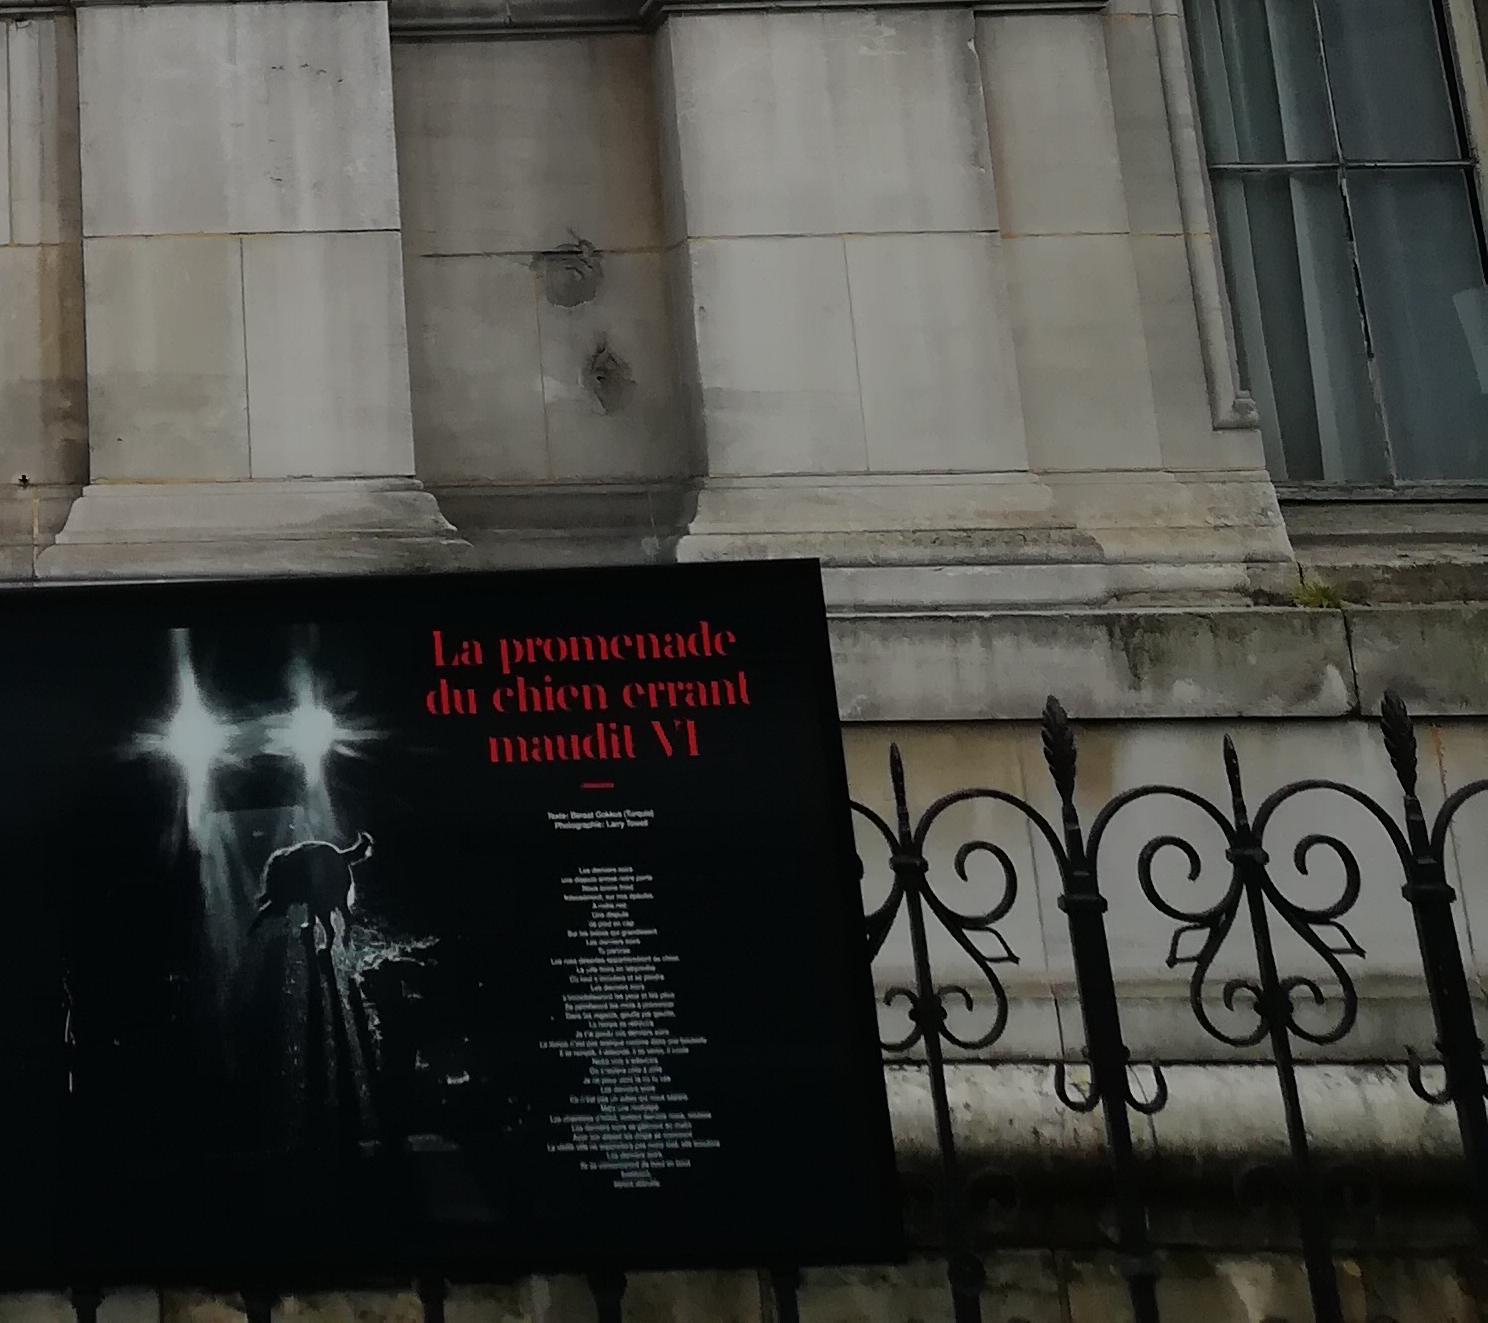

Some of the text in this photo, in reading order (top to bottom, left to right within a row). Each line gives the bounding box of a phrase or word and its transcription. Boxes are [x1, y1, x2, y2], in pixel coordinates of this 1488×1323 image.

[432, 620, 736, 675] La promenade
[425, 671, 750, 715] du chien errant
[488, 720, 699, 763] maudit VI
